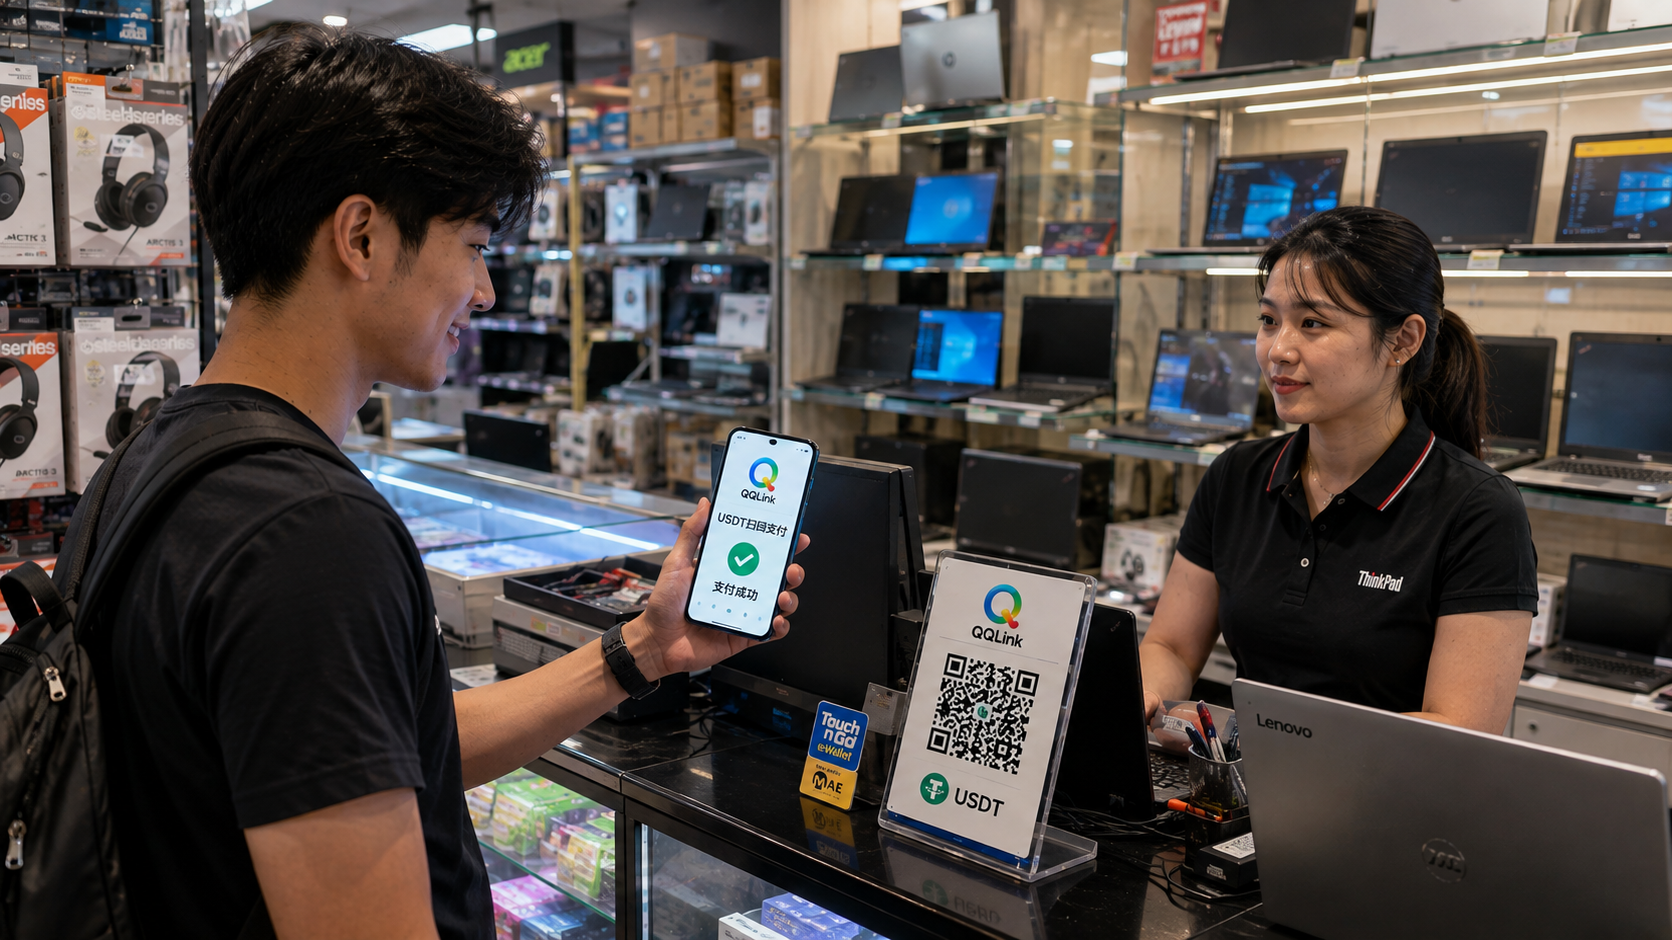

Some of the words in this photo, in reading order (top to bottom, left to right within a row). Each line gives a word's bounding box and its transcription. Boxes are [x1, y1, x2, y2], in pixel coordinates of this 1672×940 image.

[502, 41, 551, 74] acer
[741, 488, 776, 504] QQLink
[712, 581, 759, 602] 支付成功
[1357, 569, 1404, 593] ThinkPad
[971, 625, 1023, 649] QQLink
[821, 710, 861, 736] Touch
[823, 728, 833, 741] n
[1256, 713, 1313, 739] Lenovo
[812, 770, 844, 794] MAE
[954, 786, 1006, 817] USDT
